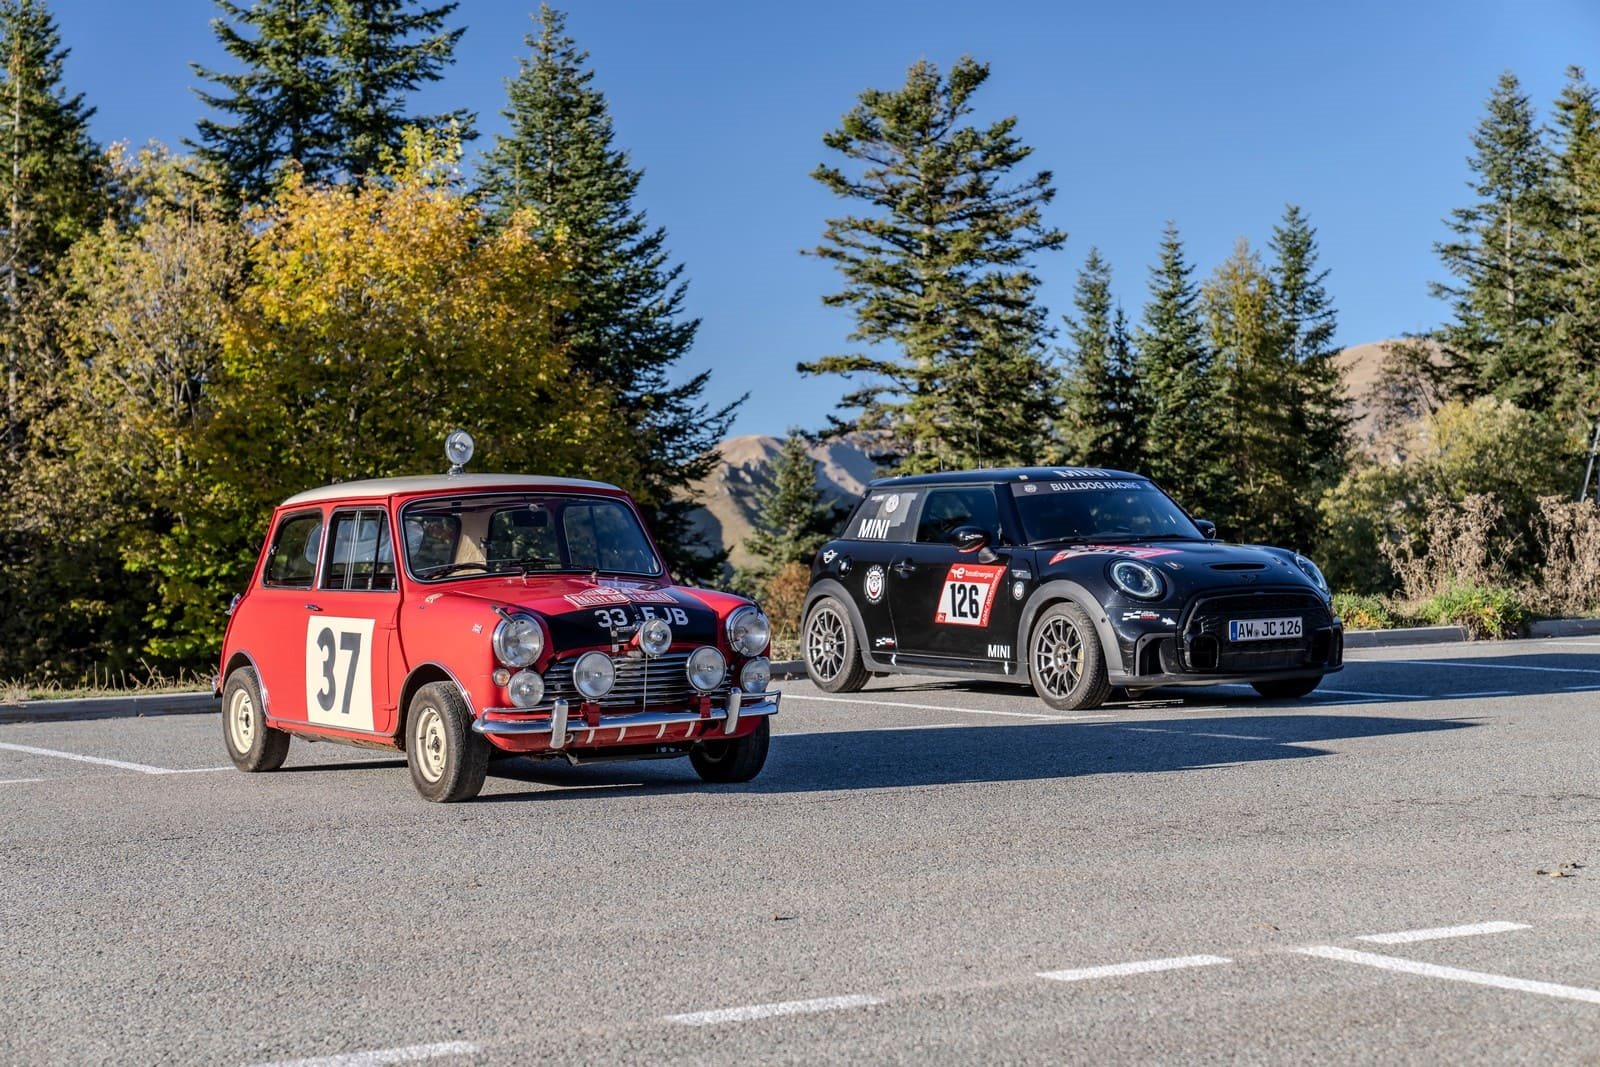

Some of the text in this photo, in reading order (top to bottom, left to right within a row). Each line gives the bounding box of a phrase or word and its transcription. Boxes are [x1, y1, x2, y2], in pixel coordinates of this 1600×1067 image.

[1050, 481, 1141, 491] BULLDOG RACING
[858, 519, 890, 539] MINI
[950, 583, 979, 619] 126
[594, 608, 628, 627] 33
[1238, 620, 1301, 637] AW JC 126
[988, 644, 1010, 658] MINI
[317, 627, 361, 714] 37
